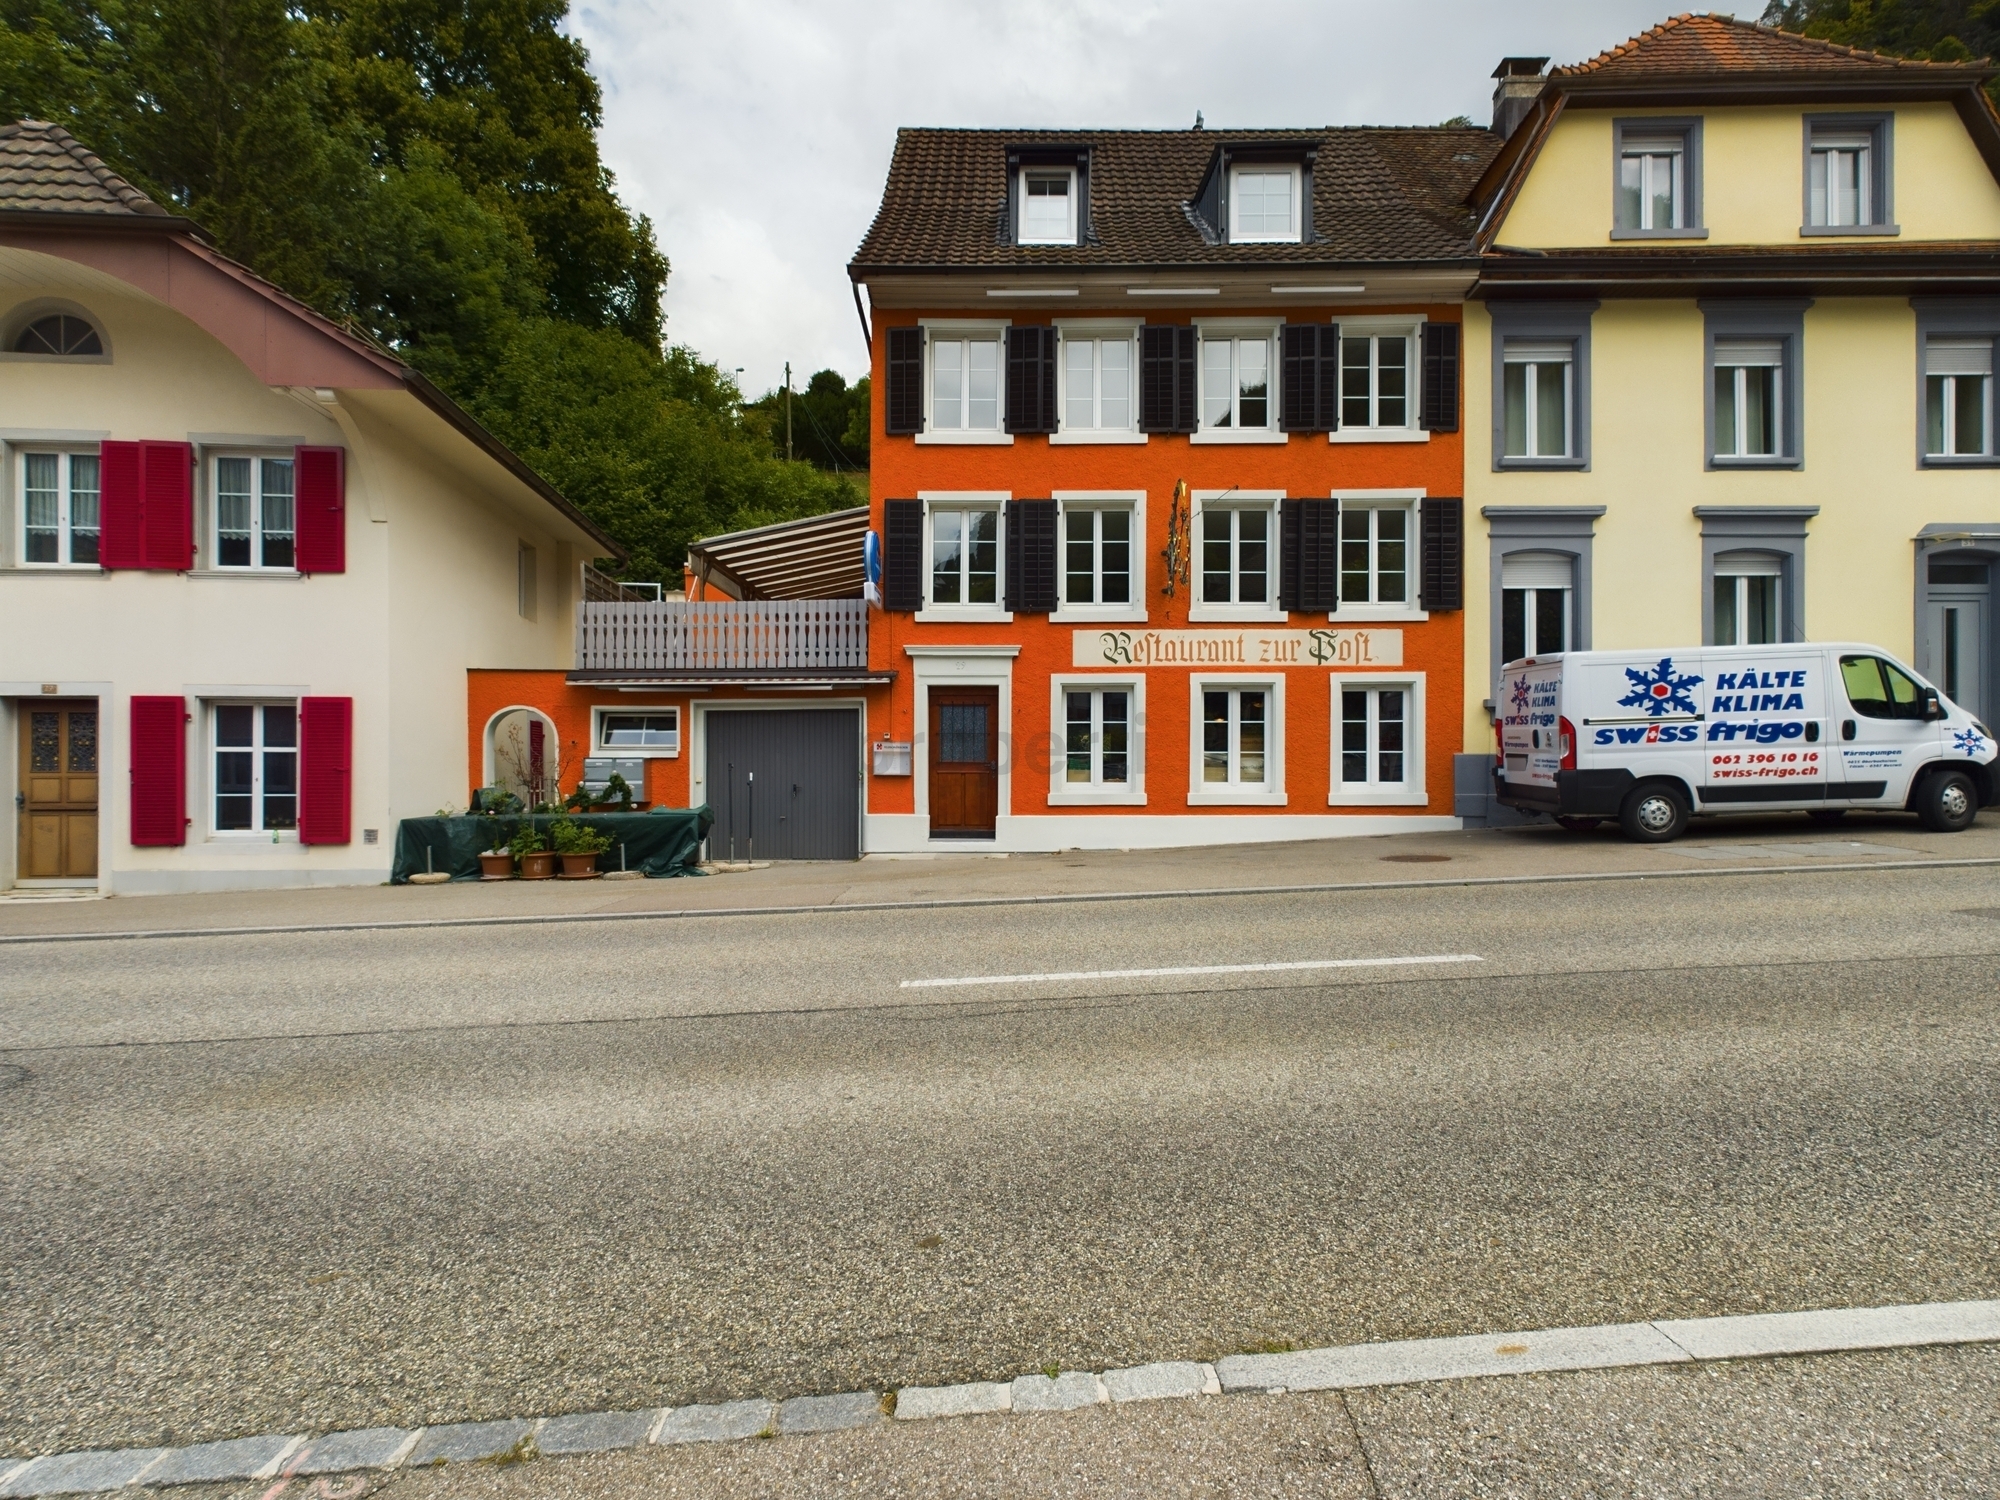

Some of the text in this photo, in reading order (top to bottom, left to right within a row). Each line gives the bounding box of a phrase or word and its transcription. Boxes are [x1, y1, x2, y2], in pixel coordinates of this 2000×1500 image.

[1099, 629, 1379, 666] Restaurant zur Post
[1533, 680, 1558, 694] KÄLTE
[1716, 668, 1807, 690] KÄLTE
[1531, 695, 1556, 708] KLIMA
[1711, 693, 1804, 713] KLIMA
[1529, 711, 1555, 727] frigo
[1707, 719, 1804, 743] frigo
[1712, 752, 1819, 765] 062 396 10 16
[1713, 766, 1819, 779] swiss-frigo.ch
